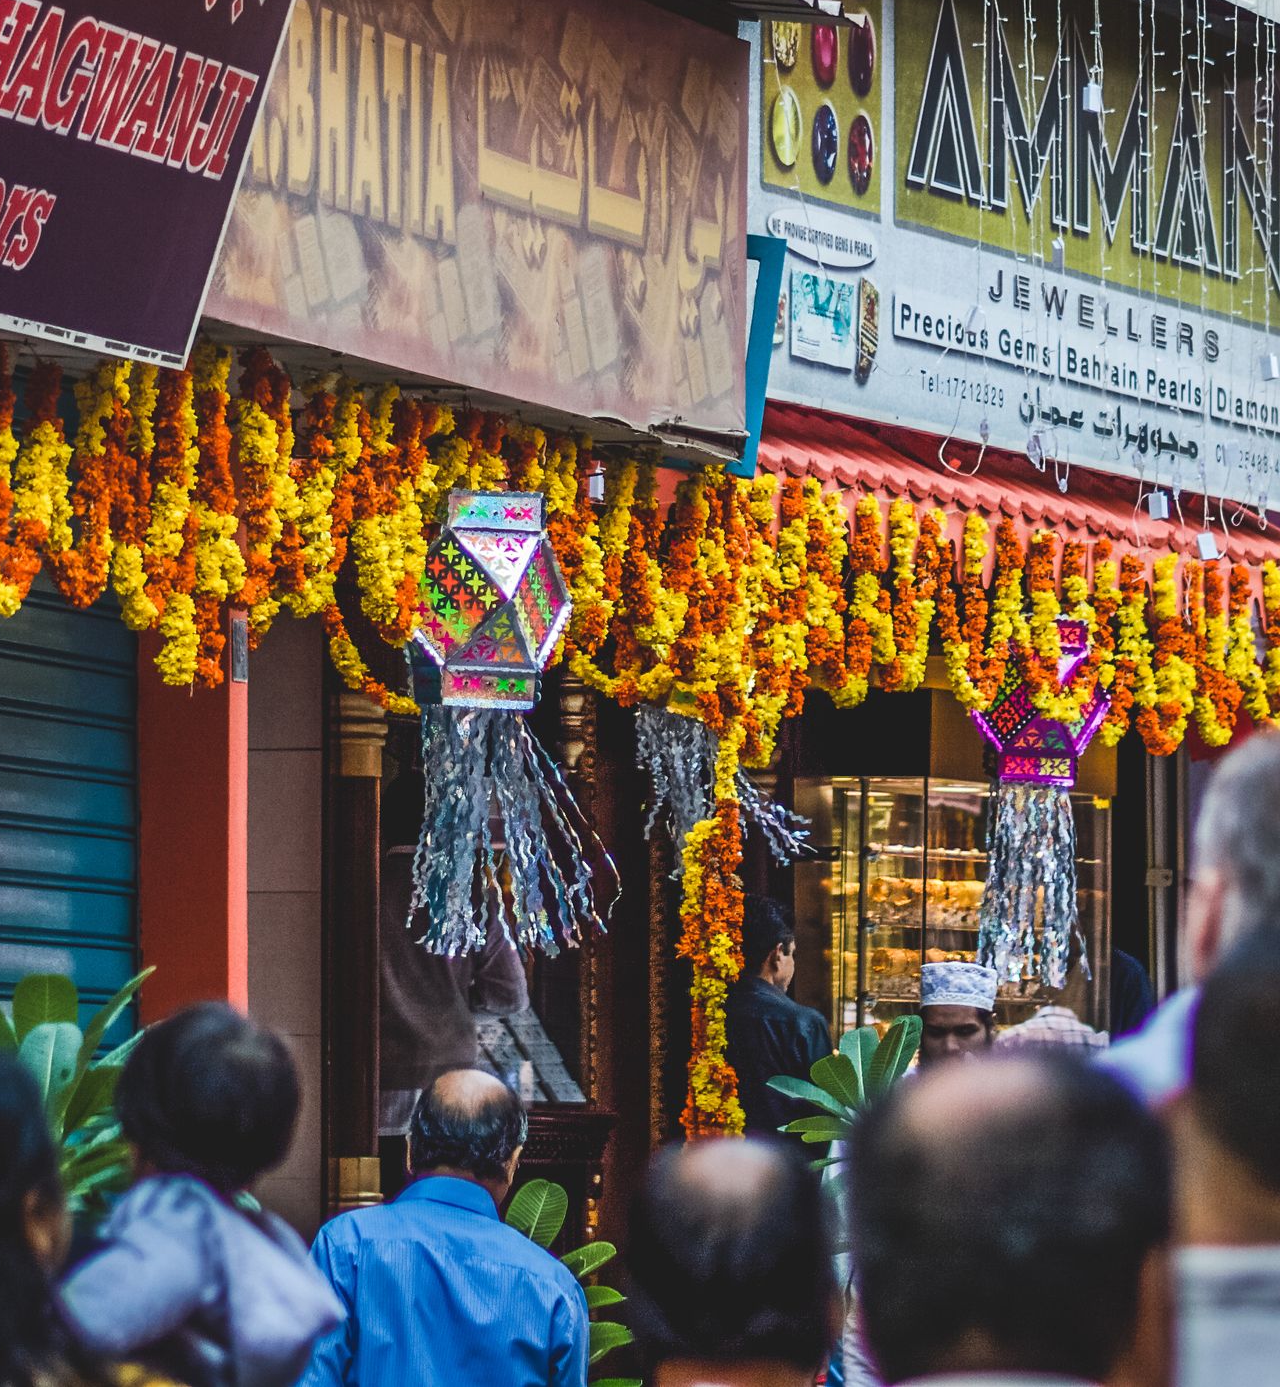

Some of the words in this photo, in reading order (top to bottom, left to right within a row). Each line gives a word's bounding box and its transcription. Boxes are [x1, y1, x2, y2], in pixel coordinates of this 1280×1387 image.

[900, 302, 990, 351] Precious
[998, 328, 1052, 368] Gems
[1067, 346, 1138, 391] Bahrain
[1146, 368, 1203, 407] Pearls
[988, 269, 1221, 363] JEWELLERS
[1092, 405, 1199, 462] مجوهرات
